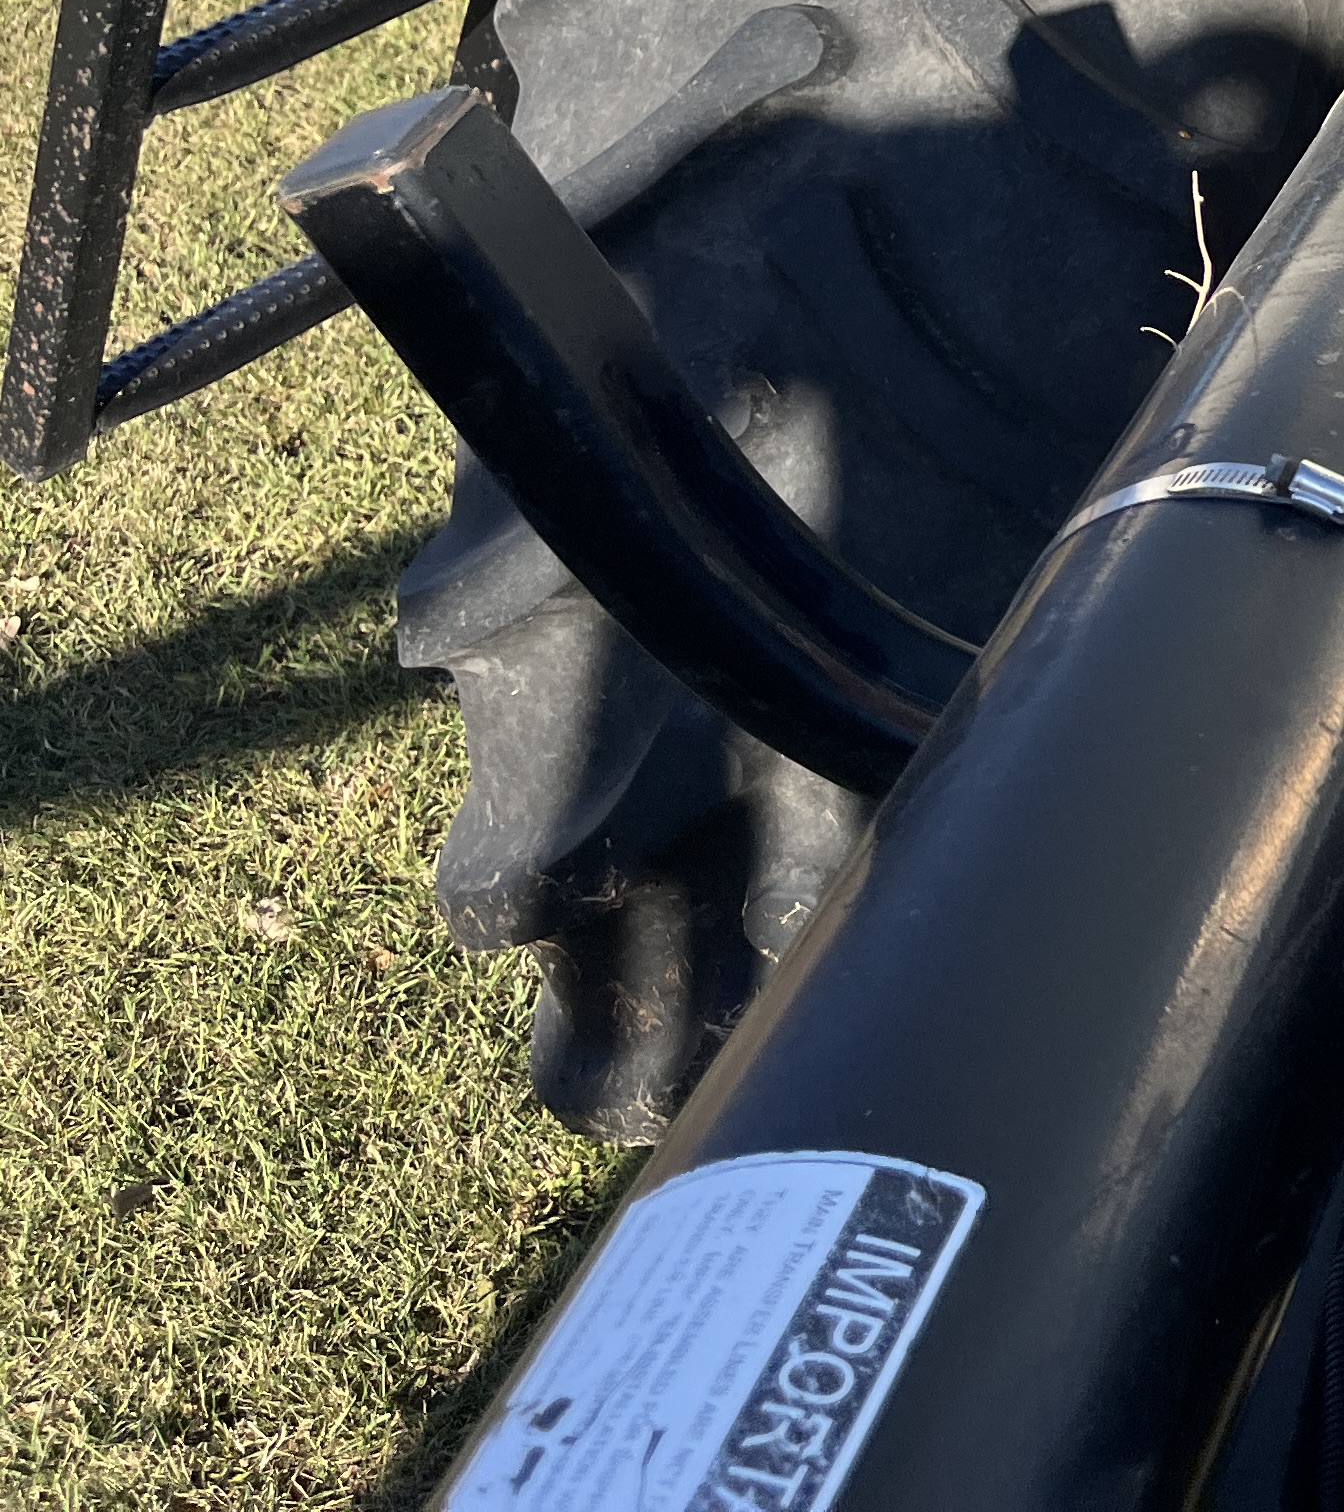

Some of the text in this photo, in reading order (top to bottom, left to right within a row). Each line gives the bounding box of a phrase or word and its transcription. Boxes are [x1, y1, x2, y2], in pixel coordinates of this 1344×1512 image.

[745, 1188, 789, 1233] THEY
[801, 1189, 844, 1235] MAIN
[715, 1245, 749, 1281] ARE
[742, 1240, 816, 1336] TRANSFER
[708, 1341, 757, 1397] LINES
